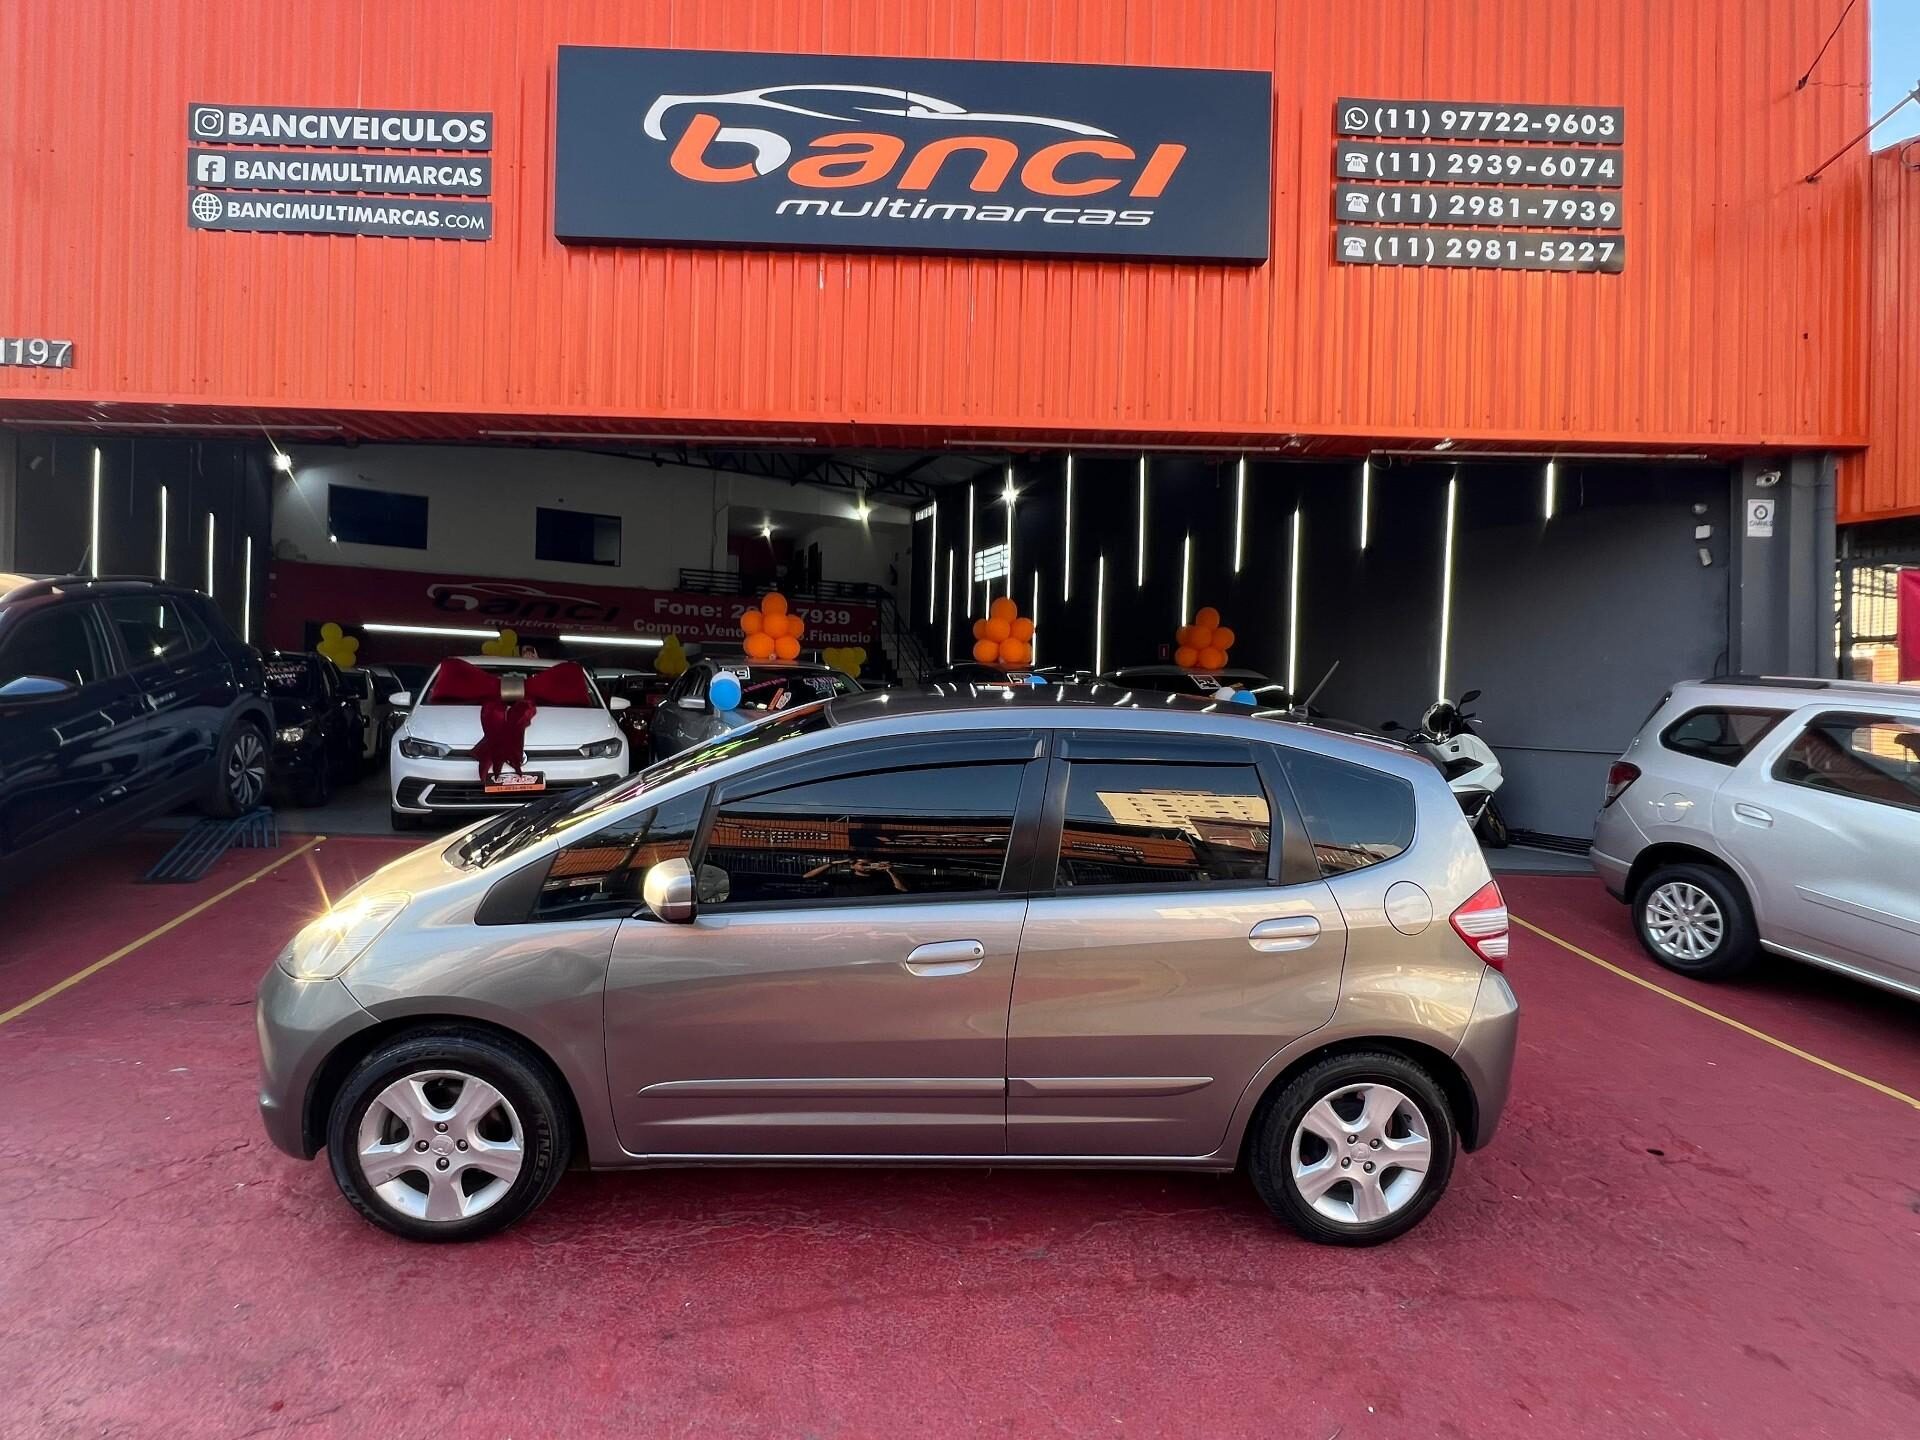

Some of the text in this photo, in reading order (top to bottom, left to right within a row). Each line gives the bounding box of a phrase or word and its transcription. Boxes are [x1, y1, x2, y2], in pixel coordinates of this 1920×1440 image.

[228, 112, 487, 143] BANCIVEICULOS
[1374, 107, 1615, 136] (11) 97722-9603
[234, 160, 483, 187] BANCIMULTIMARCAS
[1375, 151, 1615, 178] (11) 2939-6074
[227, 201, 485, 230] BANCIMULTIMARCAS.COM
[775, 196, 1154, 227] multimarcas
[1376, 191, 1616, 222] (11) 2981-7939
[1374, 235, 1616, 263] (11) 2981-5227
[654, 598, 723, 618] Fone:
